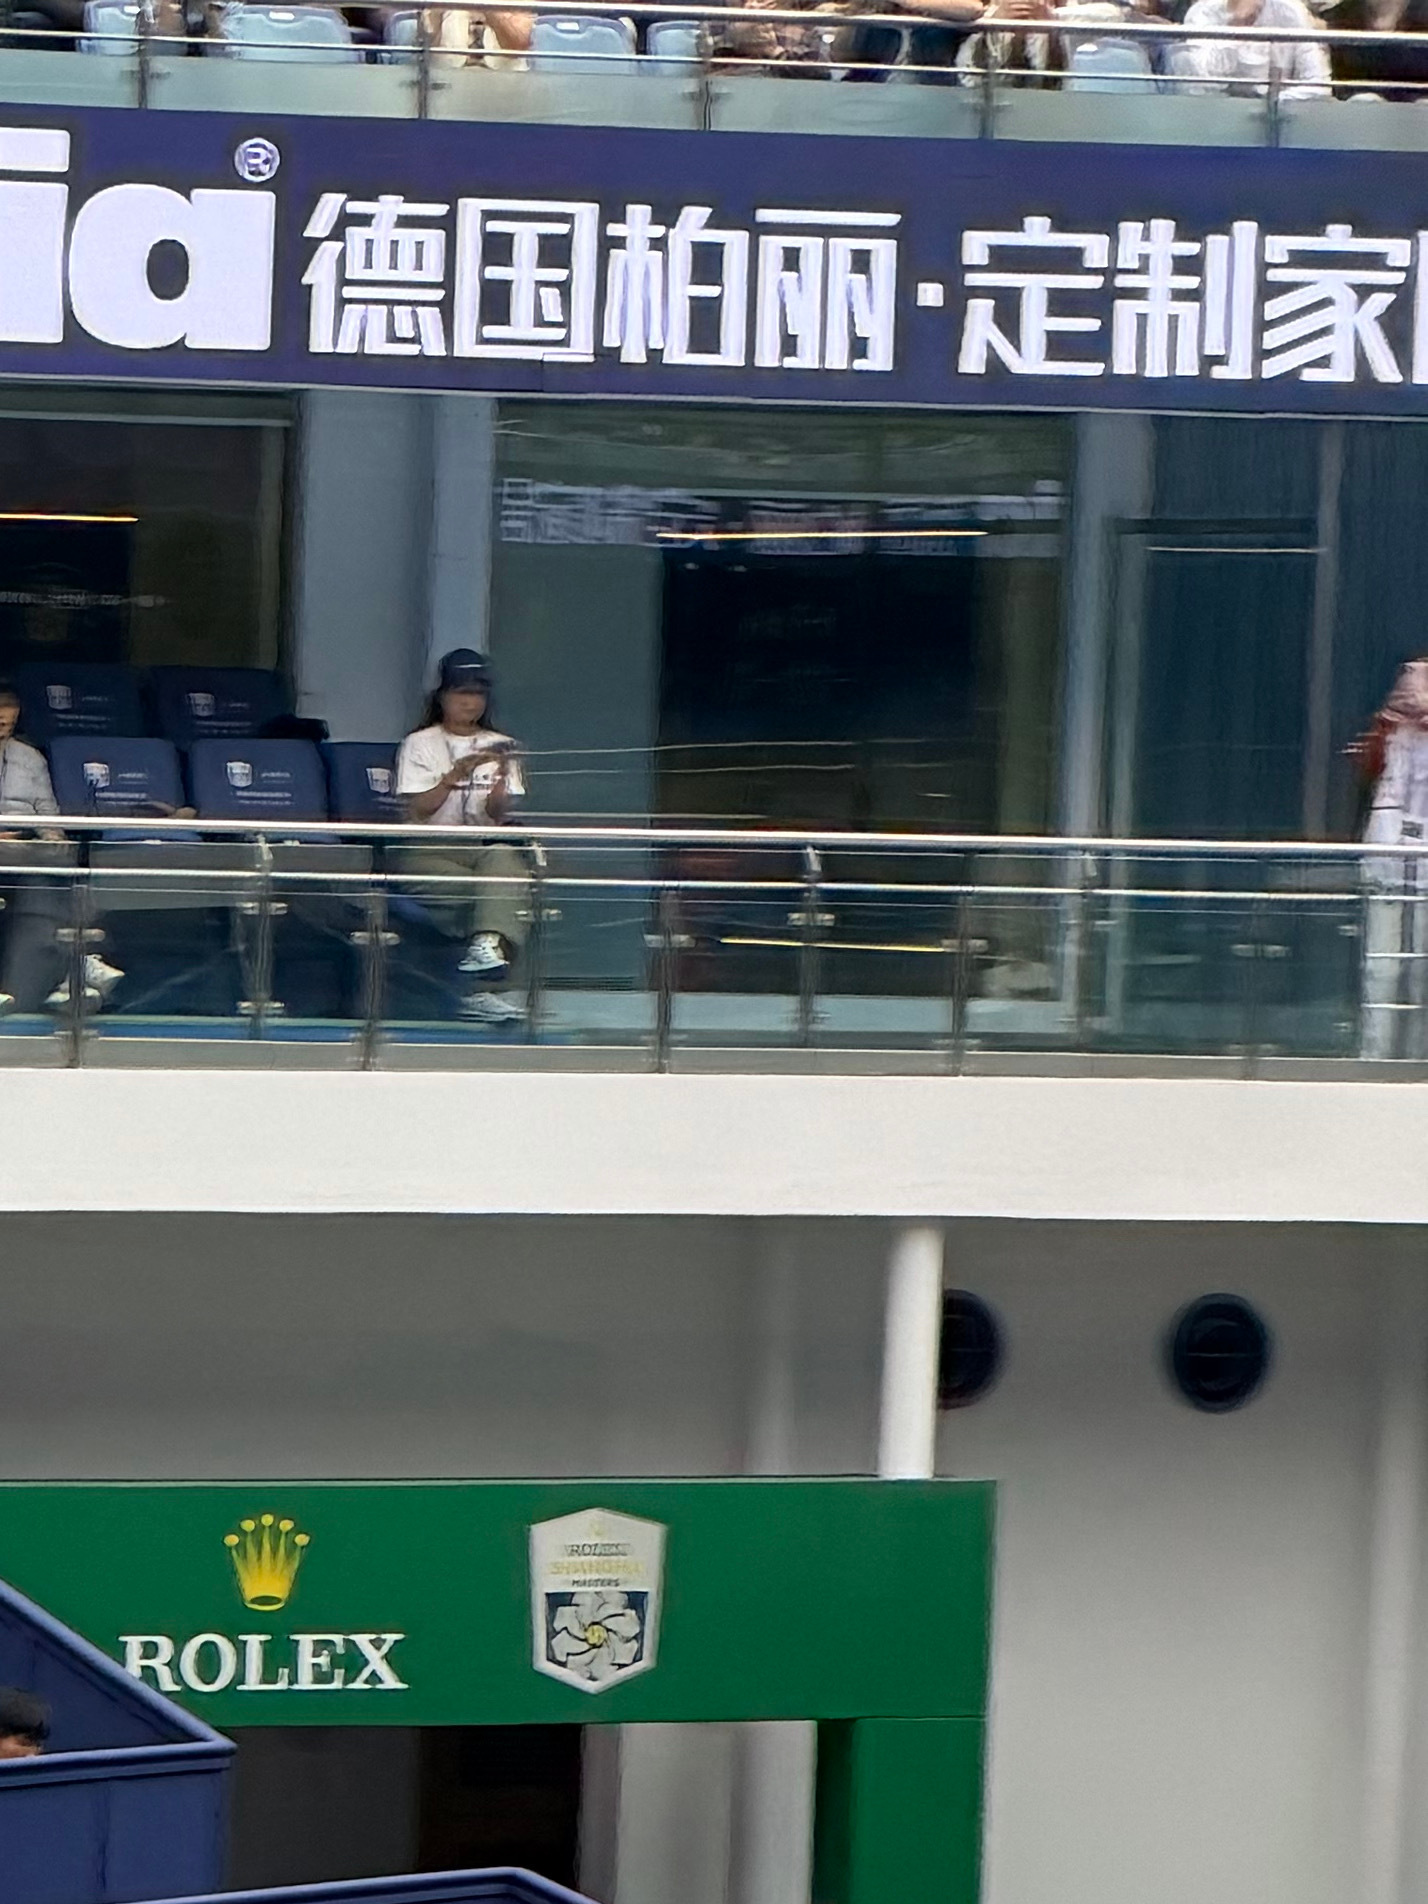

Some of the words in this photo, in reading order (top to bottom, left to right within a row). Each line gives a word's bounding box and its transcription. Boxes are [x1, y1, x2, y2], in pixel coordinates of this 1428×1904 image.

[301, 192, 1428, 385] 德国柏丽·定制家
[118, 1633, 409, 1692] ROLEX
